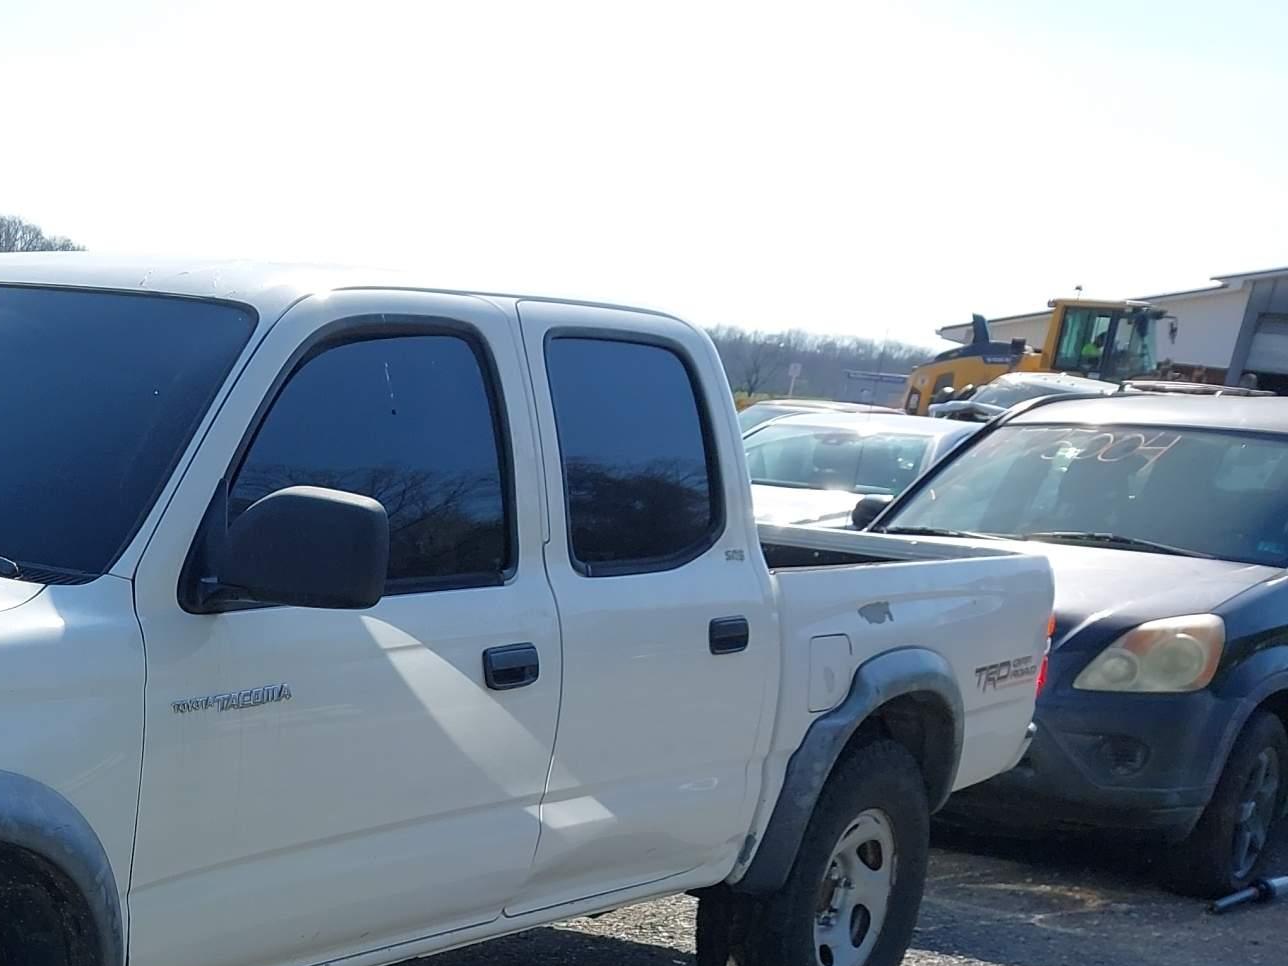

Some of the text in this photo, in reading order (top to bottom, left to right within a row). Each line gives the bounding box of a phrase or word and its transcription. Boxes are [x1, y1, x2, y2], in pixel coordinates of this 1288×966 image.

[975, 660, 1011, 694] TRD
[171, 682, 292, 713] TOYOTA TACOMA
